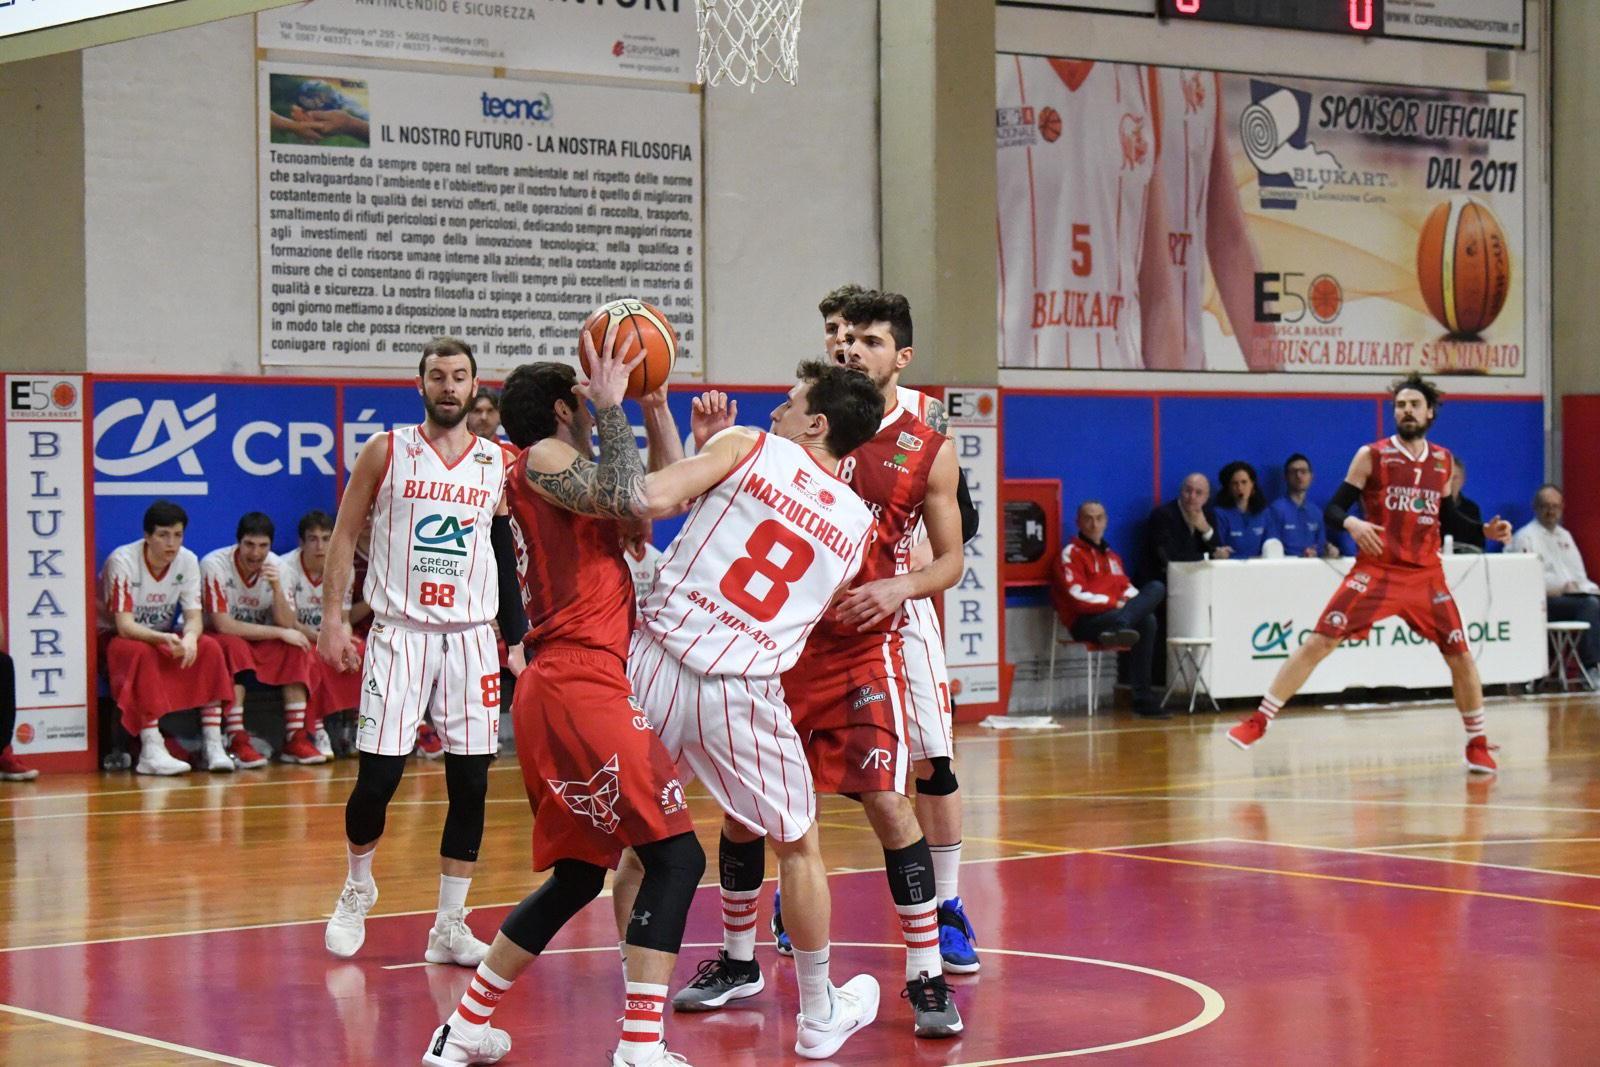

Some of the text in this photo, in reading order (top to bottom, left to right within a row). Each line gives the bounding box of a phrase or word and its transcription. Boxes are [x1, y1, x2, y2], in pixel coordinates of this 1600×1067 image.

[465, 3, 535, 20] SICUREZZA
[1319, 95, 1519, 140] SPONSOR UFFICIALE
[381, 125, 692, 161] IL NOSTRO FUTURO LA NOSTRA FILOSOFIA
[270, 150, 692, 186] Tecnoambiente sempre opera nel settore ambientale nel rispetto delle norme
[1293, 167, 1388, 187] BLUKART
[1427, 156, 1517, 193] DAL 2011
[269, 168, 289, 182] che
[292, 170, 373, 189] salvaguardano
[500, 184, 515, 197] per
[526, 183, 556, 196] nostro
[559, 185, 588, 198] futuro
[599, 187, 629, 203] quello
[643, 189, 692, 206] migliorare
[269, 187, 351, 203] costantemente
[370, 192, 406, 209] qualità
[411, 194, 426, 207] dei
[431, 195, 463, 209] servizi
[504, 199, 527, 212] nelle
[532, 201, 582, 218] operazioni
[270, 206, 339, 221] smaltimento
[356, 210, 383, 223] rifiuti
[386, 211, 437, 228] pericolosi
[448, 217, 466, 227] non
[523, 218, 573, 232] dedicando
[575, 224, 611, 237] sempre
[614, 223, 657, 239] maggiori
[660, 225, 692, 237] risorse
[270, 225, 291, 241] agli
[301, 226, 366, 240] investimenti
[376, 229, 392, 241] nel
[401, 233, 435, 246] campo
[442, 232, 467, 245] della
[475, 234, 532, 248] innovazione
[606, 240, 630, 252] nella
[638, 241, 678, 257] qualifica
[1072, 224, 1092, 277] 5
[270, 243, 332, 257] formazione
[336, 246, 362, 259] delle
[367, 247, 402, 260] risorse
[406, 251, 441, 262] umane
[445, 250, 479, 263] interne
[483, 252, 501, 264] alla
[548, 255, 572, 267] nella
[575, 256, 616, 269] costante
[620, 258, 679, 274] applicazione
[271, 262, 679, 288] misure che consentano raggiungere livelli sempre più eccellenti materia
[271, 281, 309, 297] qualità
[399, 285, 430, 297] nostra
[434, 286, 474, 299] filosofia
[489, 288, 521, 304] spinge
[535, 290, 591, 303] considerare
[271, 299, 295, 315] ogni
[298, 300, 332, 316] giorno
[334, 301, 383, 314] mettiamo
[395, 303, 456, 319] disposizione
[469, 305, 499, 318] nostra
[286, 318, 317, 331] modo
[321, 319, 342, 332] tale
[346, 320, 365, 332] che
[370, 323, 400, 336] possa
[404, 321, 445, 334] ricevere
[465, 323, 503, 336] servizio
[539, 326, 580, 339] efficient
[271, 336, 532, 359] coniugare ragioni rispetto
[1336, 341, 1414, 366] BLUKART
[403, 479, 490, 509] BLUKART
[743, 472, 854, 563] MAZZUCCHELLI
[27, 431, 65, 696] BLUKART
[412, 564, 465, 577] AGRICOLE
[420, 555, 460, 568] CRÉDIT
[719, 518, 815, 622] 8
[419, 582, 456, 608] 88
[686, 590, 777, 652] SAN MINIATO
[1391, 621, 1510, 646] AGOLE
